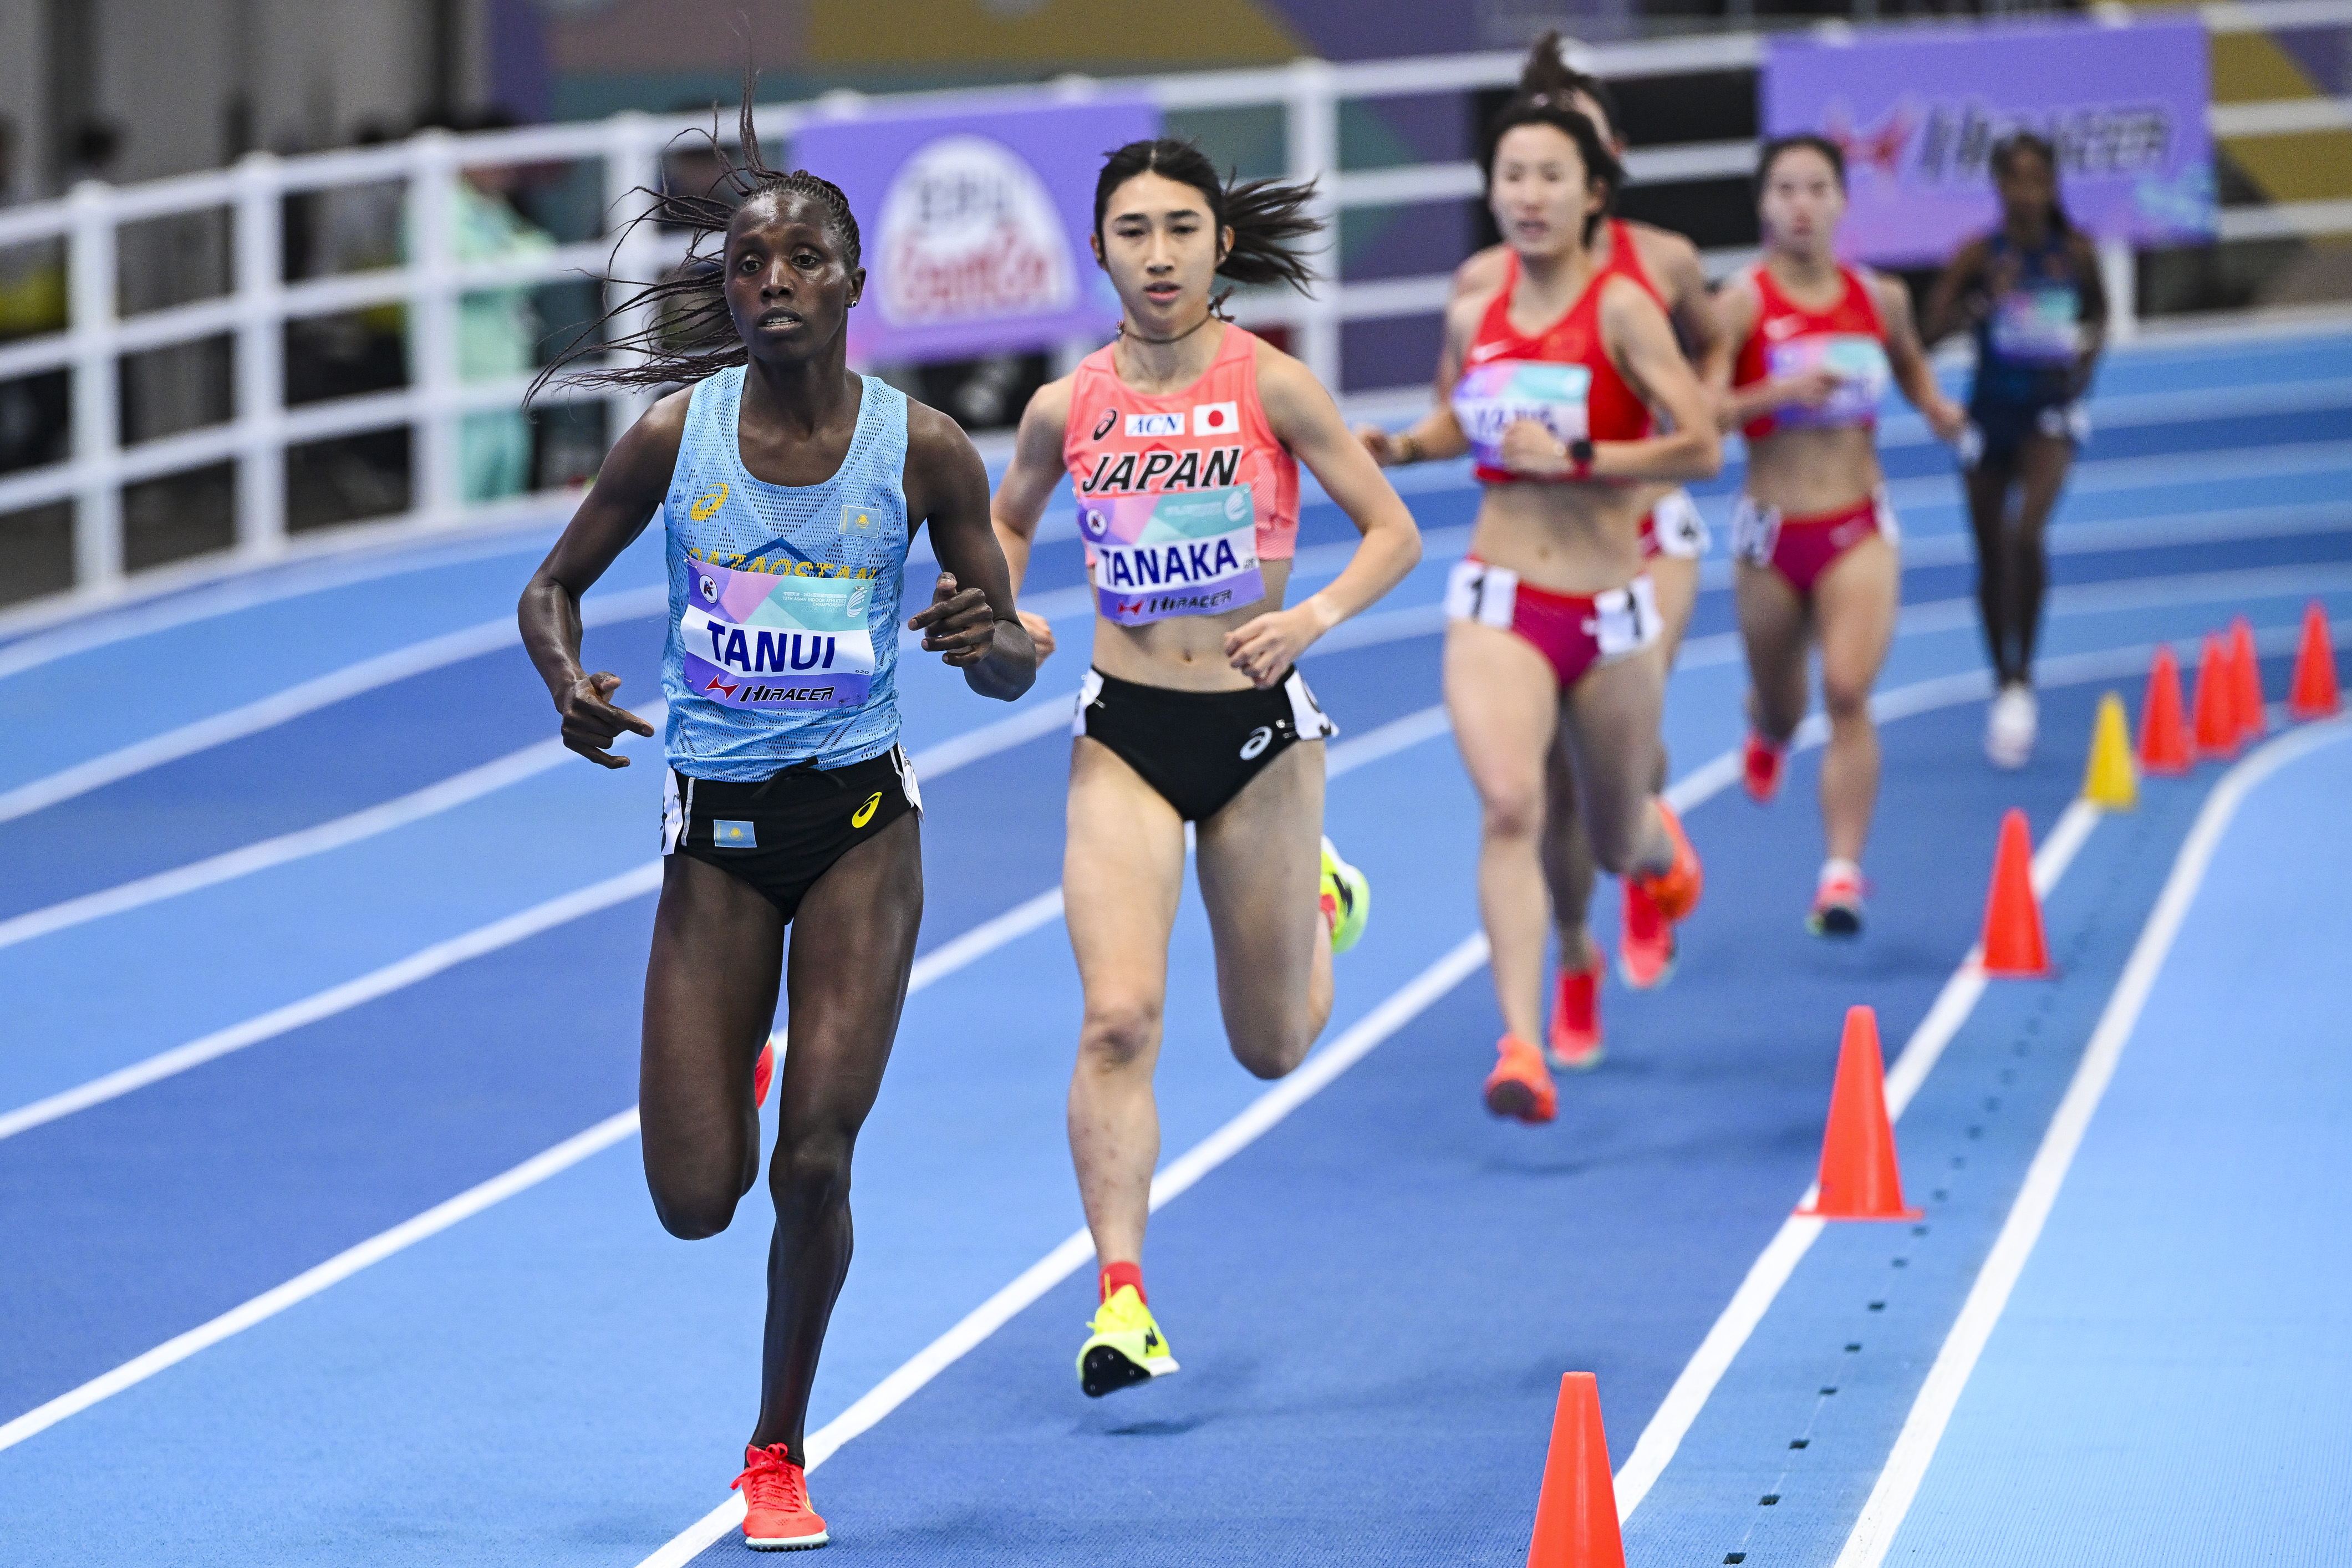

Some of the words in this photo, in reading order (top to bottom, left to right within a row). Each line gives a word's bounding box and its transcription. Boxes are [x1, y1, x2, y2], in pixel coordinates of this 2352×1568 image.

[1128, 415, 1181, 435] ACN
[1081, 447, 1241, 492] JAPAN
[1100, 539, 1239, 587] TANAKA
[707, 620, 836, 673] TANUI
[739, 685, 834, 702] HIRACER
